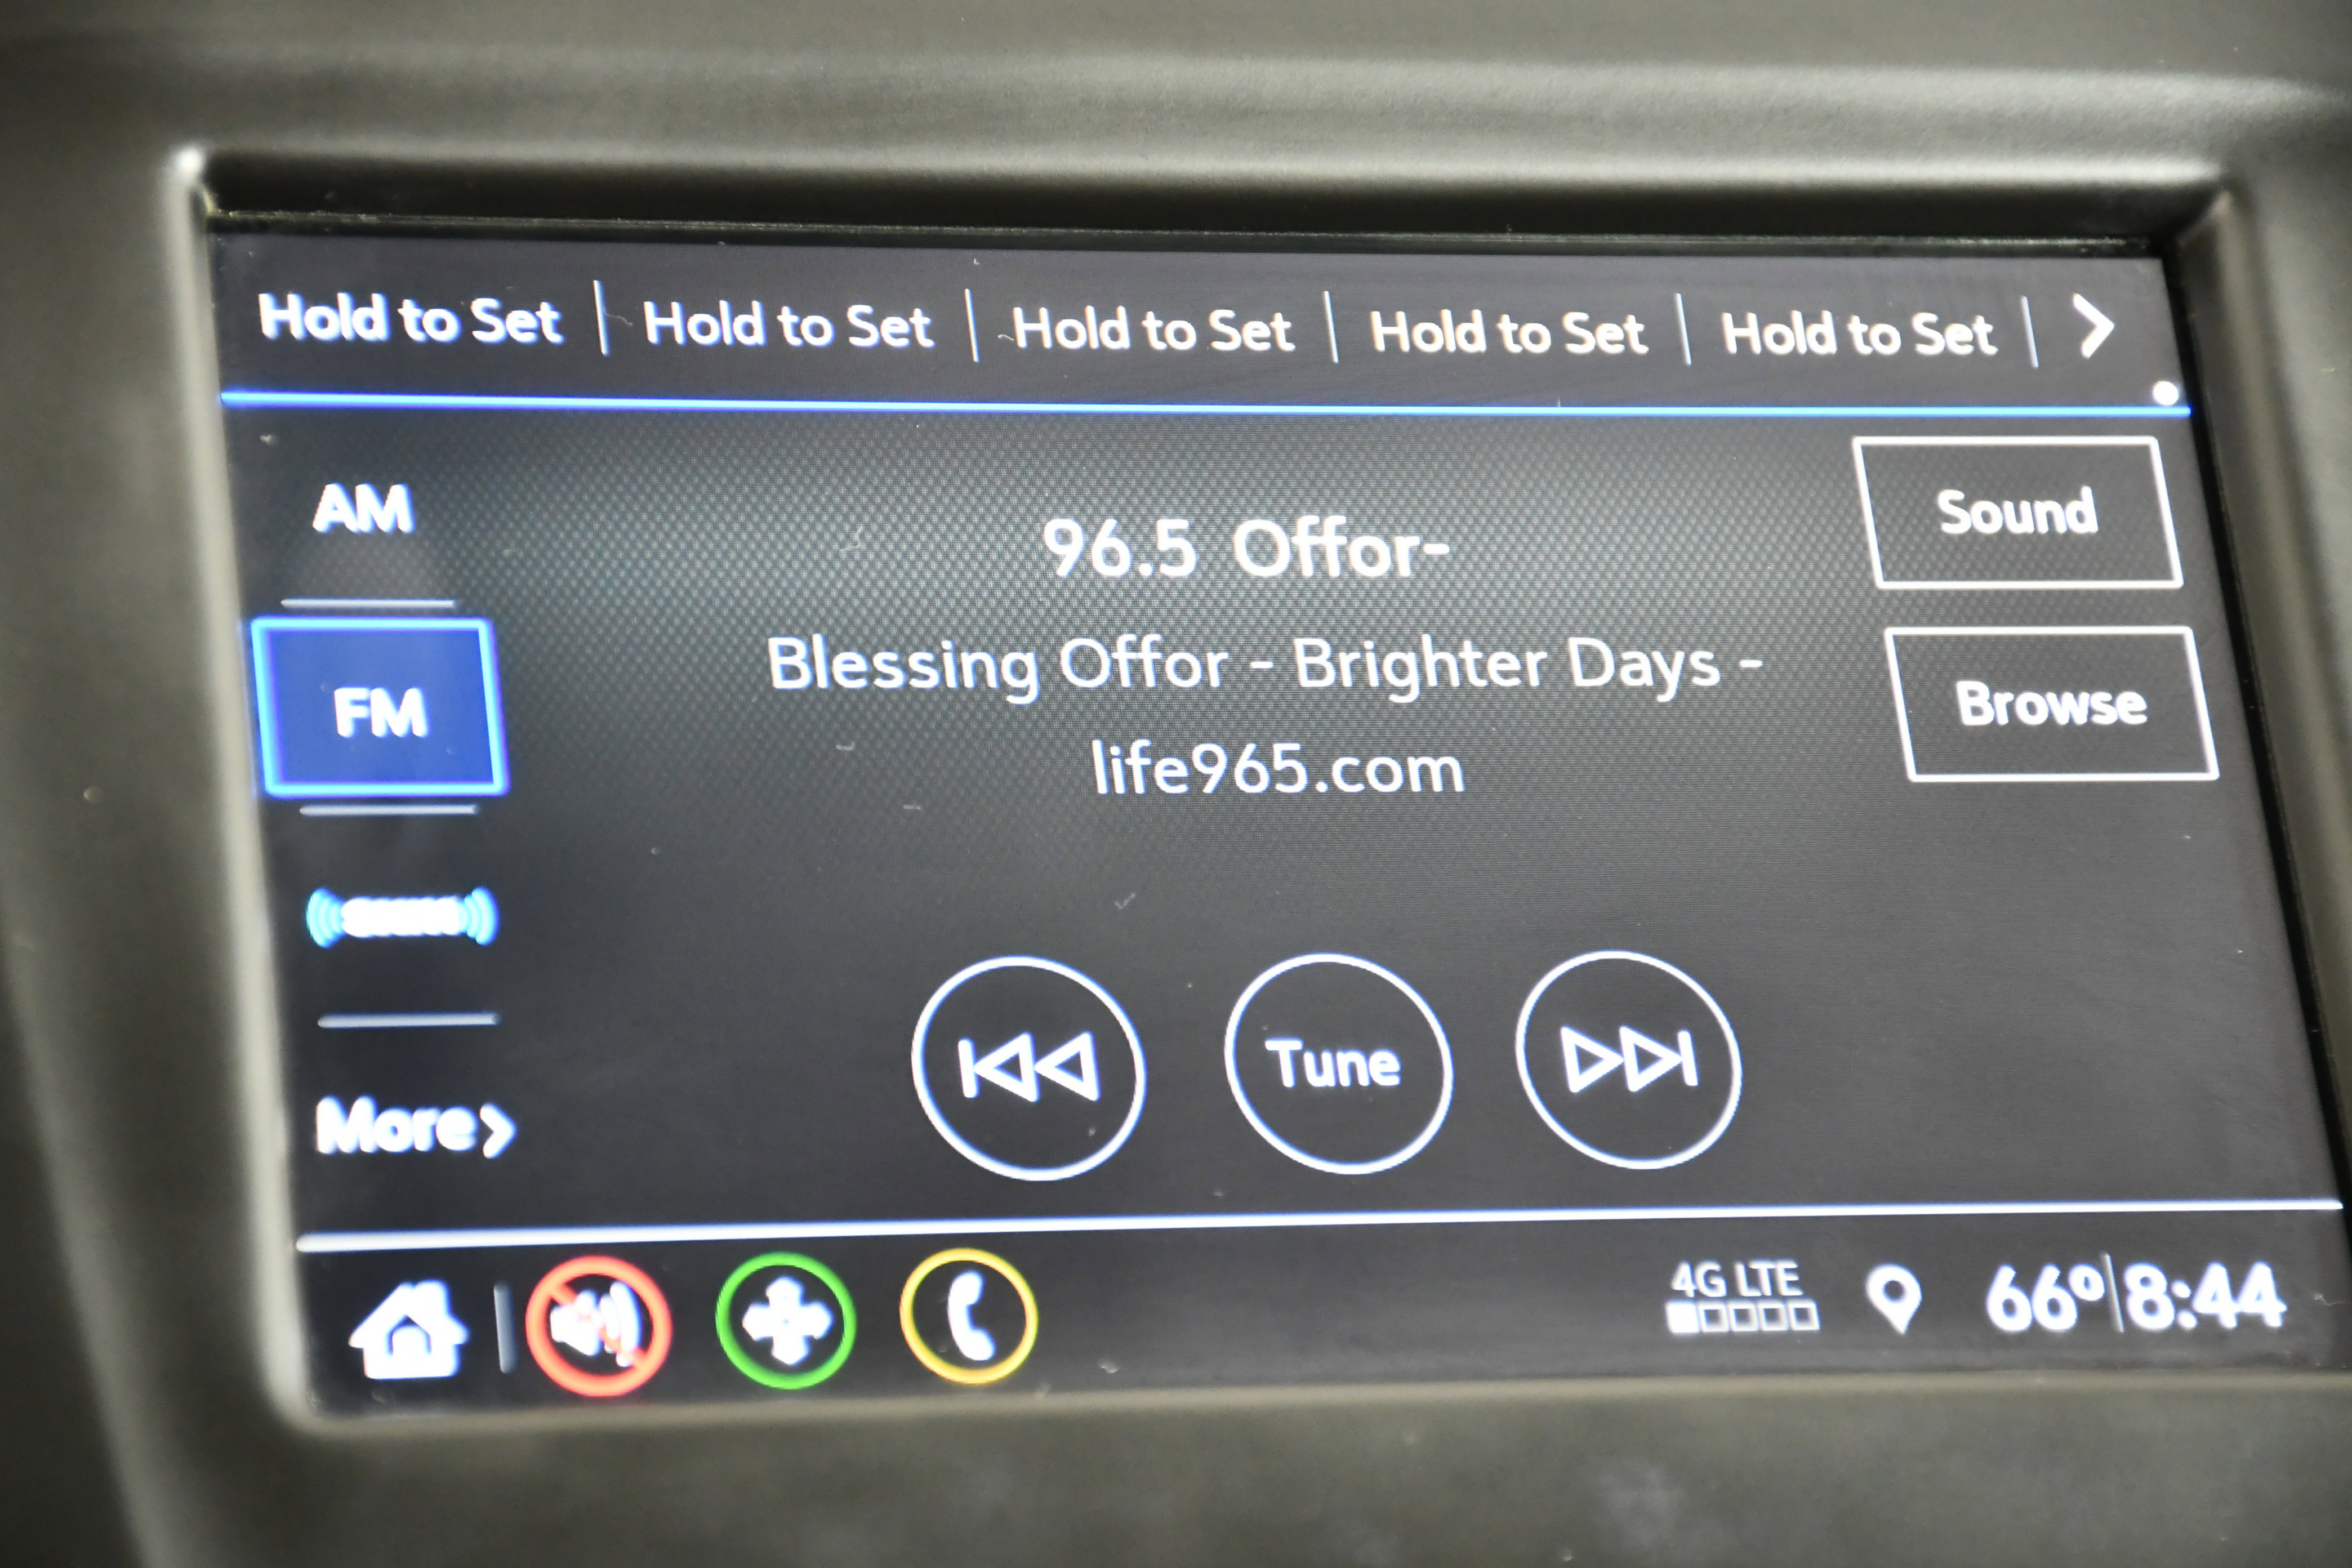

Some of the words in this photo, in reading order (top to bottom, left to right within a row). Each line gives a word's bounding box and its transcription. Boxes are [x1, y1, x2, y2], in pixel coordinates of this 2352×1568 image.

[258, 291, 389, 341] Hold
[397, 298, 460, 342] to
[470, 297, 563, 344] Set
[643, 299, 765, 346] Hold
[776, 305, 834, 347] to
[846, 303, 935, 348] Set
[1012, 304, 1131, 350] Hold
[1141, 310, 1197, 351] to
[1208, 308, 1296, 352] Set
[1370, 308, 1487, 354] Hold
[1496, 313, 1552, 354] to
[1561, 310, 1649, 355] Set
[1721, 309, 1838, 355] Hold
[1846, 314, 1902, 356] to
[1910, 311, 1998, 356] Set
[311, 483, 413, 533] AM
[1936, 484, 2099, 536] Sound
[1042, 516, 1199, 578] 96.5
[1231, 513, 1450, 579] Offor-
[768, 632, 1041, 705] Blessing
[1059, 631, 1230, 688] Offor
[1292, 632, 1548, 704] Brighter
[1566, 635, 1721, 703] Days
[333, 686, 429, 738] FM
[1954, 679, 2148, 727] Browse
[1091, 738, 1464, 795] life965.com
[1264, 1037, 1401, 1088] Tune
[315, 1096, 480, 1155] More
[1671, 1260, 1727, 1298] 4G
[1735, 1259, 1803, 1298] LTE
[2124, 1262, 2287, 1332] 8:44
